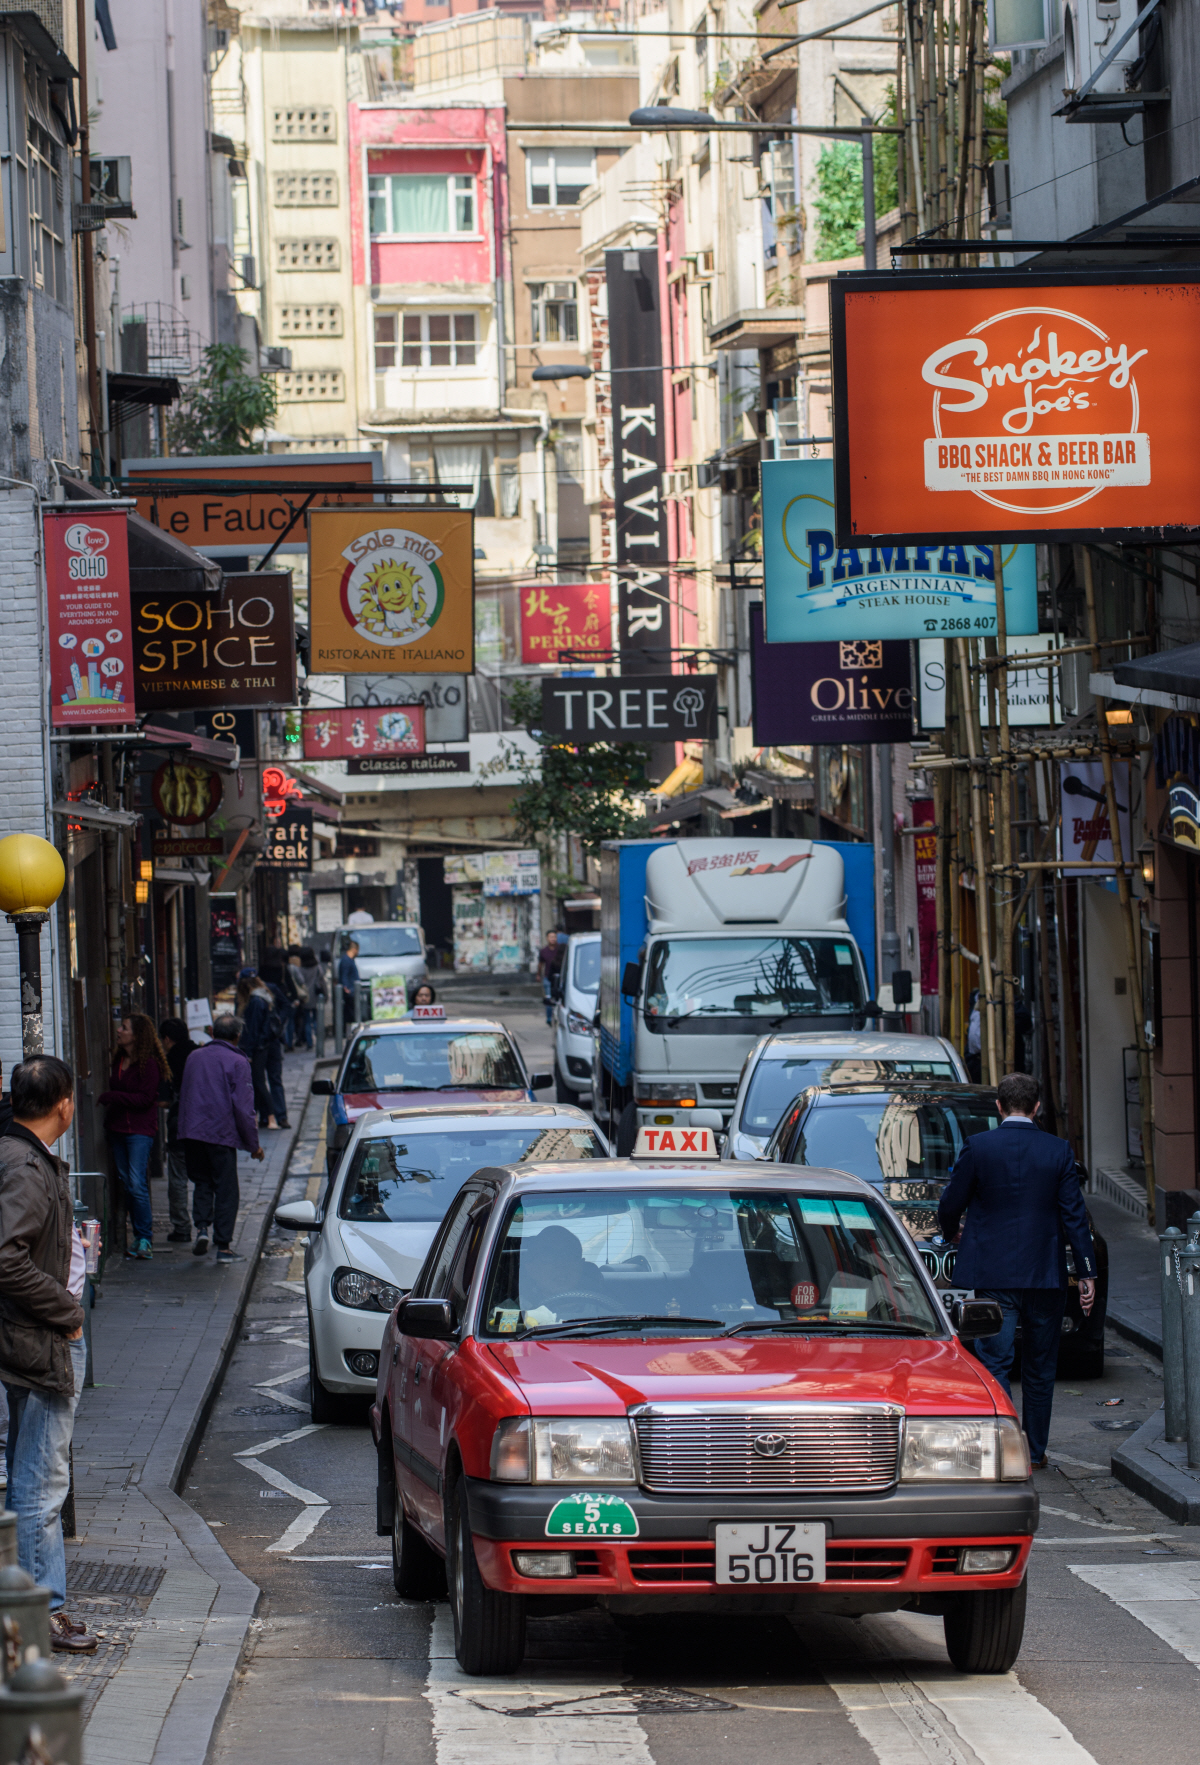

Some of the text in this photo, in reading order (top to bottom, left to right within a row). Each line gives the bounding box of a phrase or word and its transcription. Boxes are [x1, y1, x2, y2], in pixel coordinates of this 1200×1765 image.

[921, 331, 1148, 413] Smokey
[1002, 381, 1090, 434] Joe's
[938, 440, 1136, 469] BBQ SHACK & BEER BAR
[983, 471, 1004, 482] BEST
[1006, 470, 1030, 482] DAMN
[1032, 470, 1050, 482] BBQ
[1051, 470, 1060, 481] IN
[1062, 469, 1085, 480] HONG
[620, 403, 663, 638] KAVIAR
[87, 536, 105, 545] love
[350, 531, 436, 564] Sole mio
[70, 556, 106, 578] SOHO
[841, 577, 967, 598] ARGENTINIAN
[84, 602, 102, 610] GUIDE
[858, 594, 951, 609] STEAK HOUSE
[137, 596, 275, 634] SOHO
[525, 588, 572, 635] 北京
[68, 617, 113, 626] AROUND SOHO
[940, 616, 997, 631] 2868 407
[529, 634, 600, 649] PEKING
[139, 635, 278, 672] SPICE
[318, 649, 465, 660] RISTORANTE ITALIANO
[142, 676, 276, 693] VIETNAMESE & THAI
[810, 674, 913, 712] Olive
[553, 688, 670, 730] TREE
[811, 714, 838, 722] GREEK
[838, 714, 845, 722] &
[846, 713, 879, 721] MIDDLE
[359, 757, 408, 772] Classic
[411, 755, 458, 770] Italian
[265, 822, 309, 841] raft
[258, 841, 309, 860] teak
[687, 850, 760, 876] 最強版
[416, 1007, 443, 1017] TAXI
[644, 1130, 708, 1152] TAXI
[794, 1294, 815, 1305] HIRE
[797, 1285, 815, 1295] FOR
[584, 1502, 601, 1522] 5
[562, 1522, 622, 1535] SEATS
[747, 1524, 797, 1554] JZ
[728, 1552, 815, 1584] 5016
